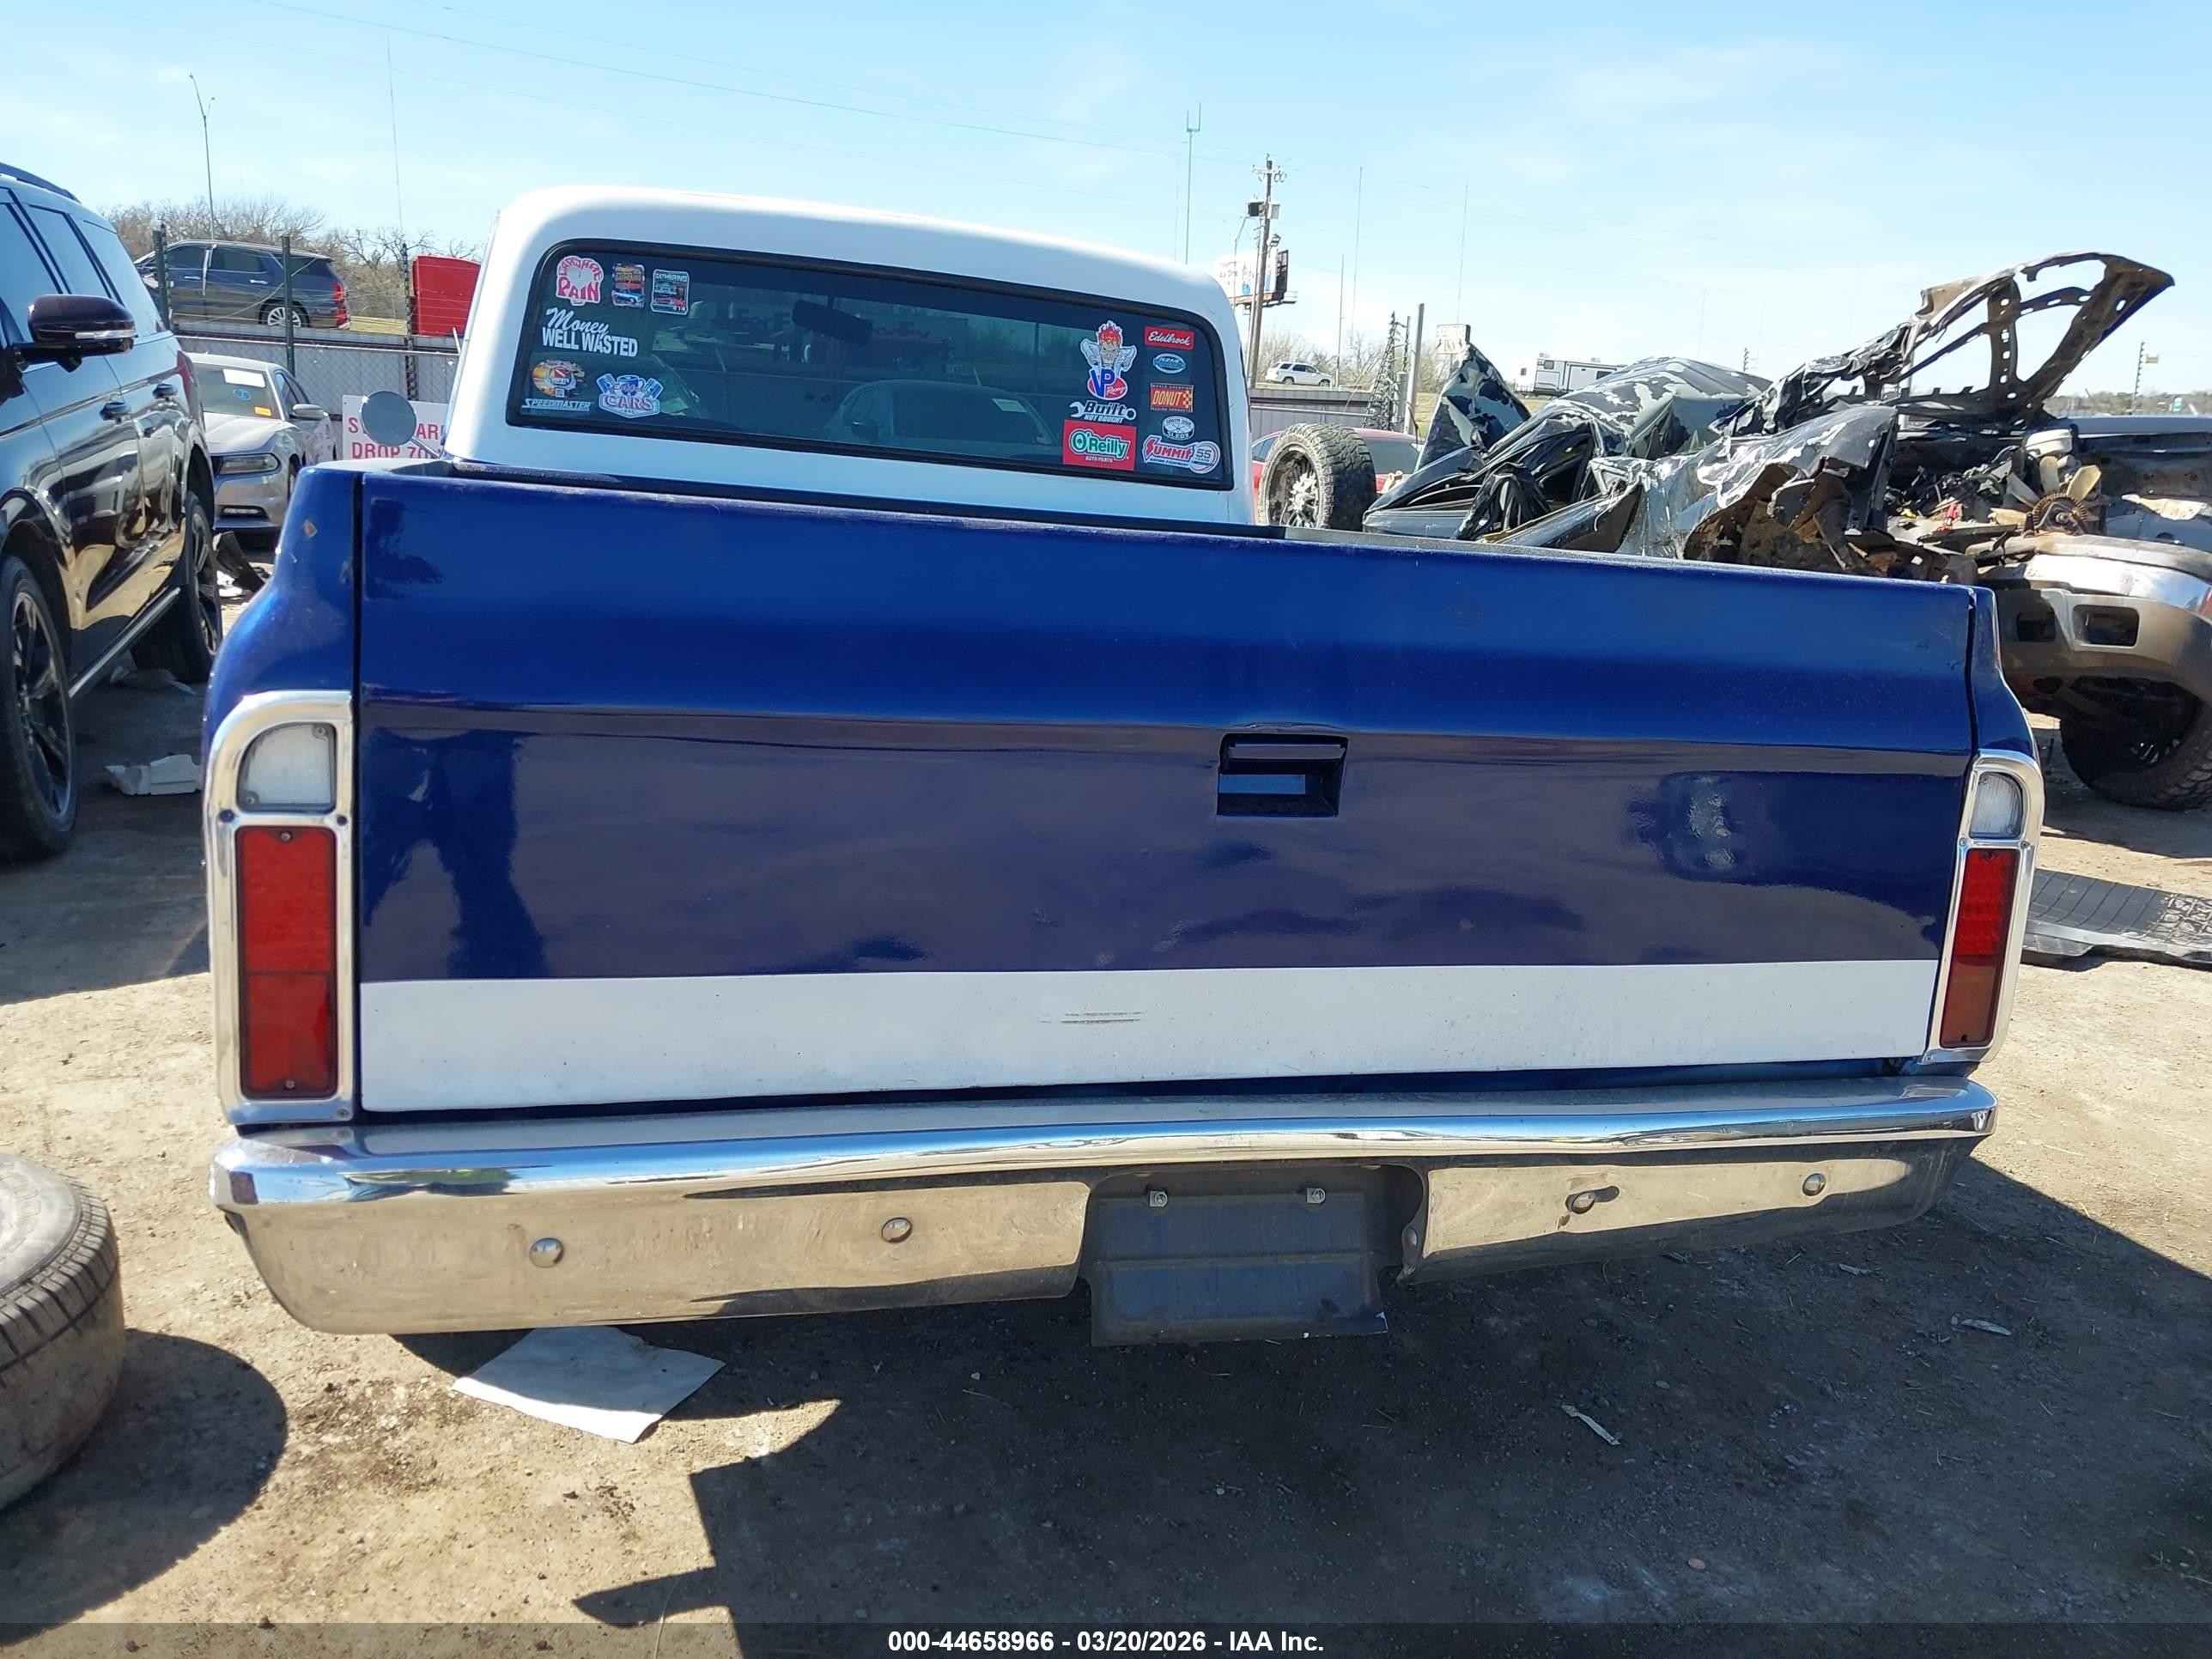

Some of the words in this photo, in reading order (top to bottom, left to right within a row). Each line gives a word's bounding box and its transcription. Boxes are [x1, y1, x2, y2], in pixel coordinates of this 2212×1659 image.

[655, 273, 688, 283] GATHERING
[546, 307, 610, 338] Money
[542, 326, 580, 351] WELL
[581, 333, 638, 357] WASTED
[1148, 331, 1191, 345] Edelbrock
[1090, 369, 1115, 398] VP
[522, 398, 591, 411] SPEEDMASTER
[605, 394, 654, 410] CARS
[1152, 390, 1183, 406] DONUT
[1085, 400, 1127, 416] Built
[1097, 415, 1125, 423] BOUGHT
[1072, 431, 1126, 458] O'Reilly
[1195, 448, 1212, 459] 55
